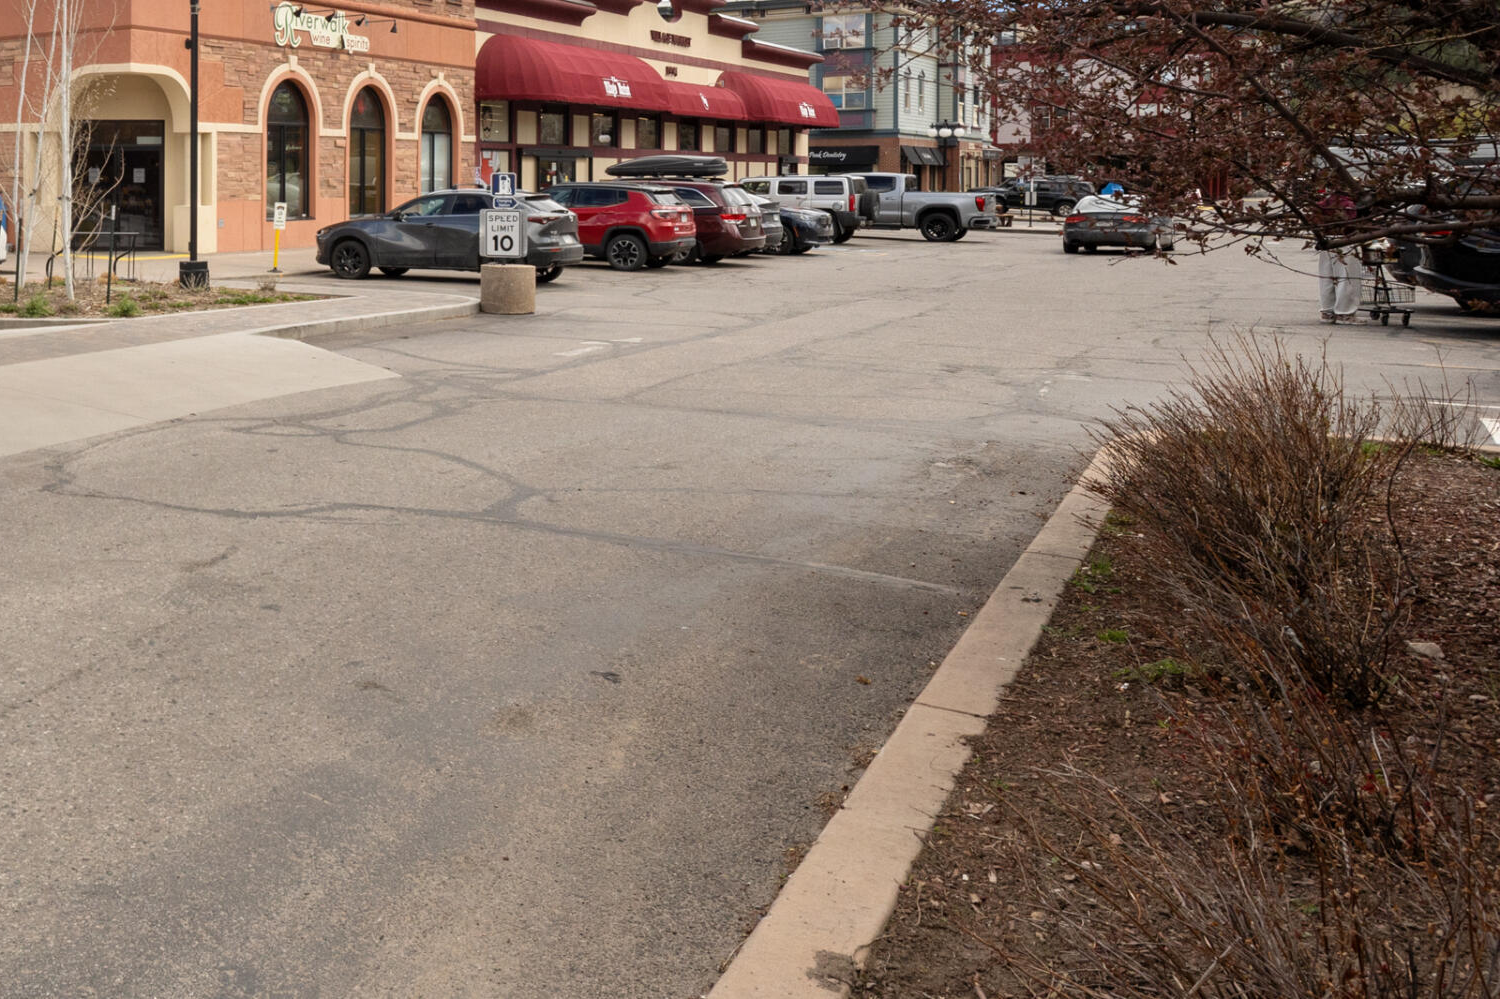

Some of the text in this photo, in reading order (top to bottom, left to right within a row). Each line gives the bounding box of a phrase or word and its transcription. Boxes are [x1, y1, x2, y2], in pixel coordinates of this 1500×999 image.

[276, 3, 348, 46] Riverwalk
[313, 31, 369, 52] wine spirits
[823, 151, 847, 161] Dentistry
[488, 214, 518, 222] SPEED
[492, 234, 514, 251] 10
